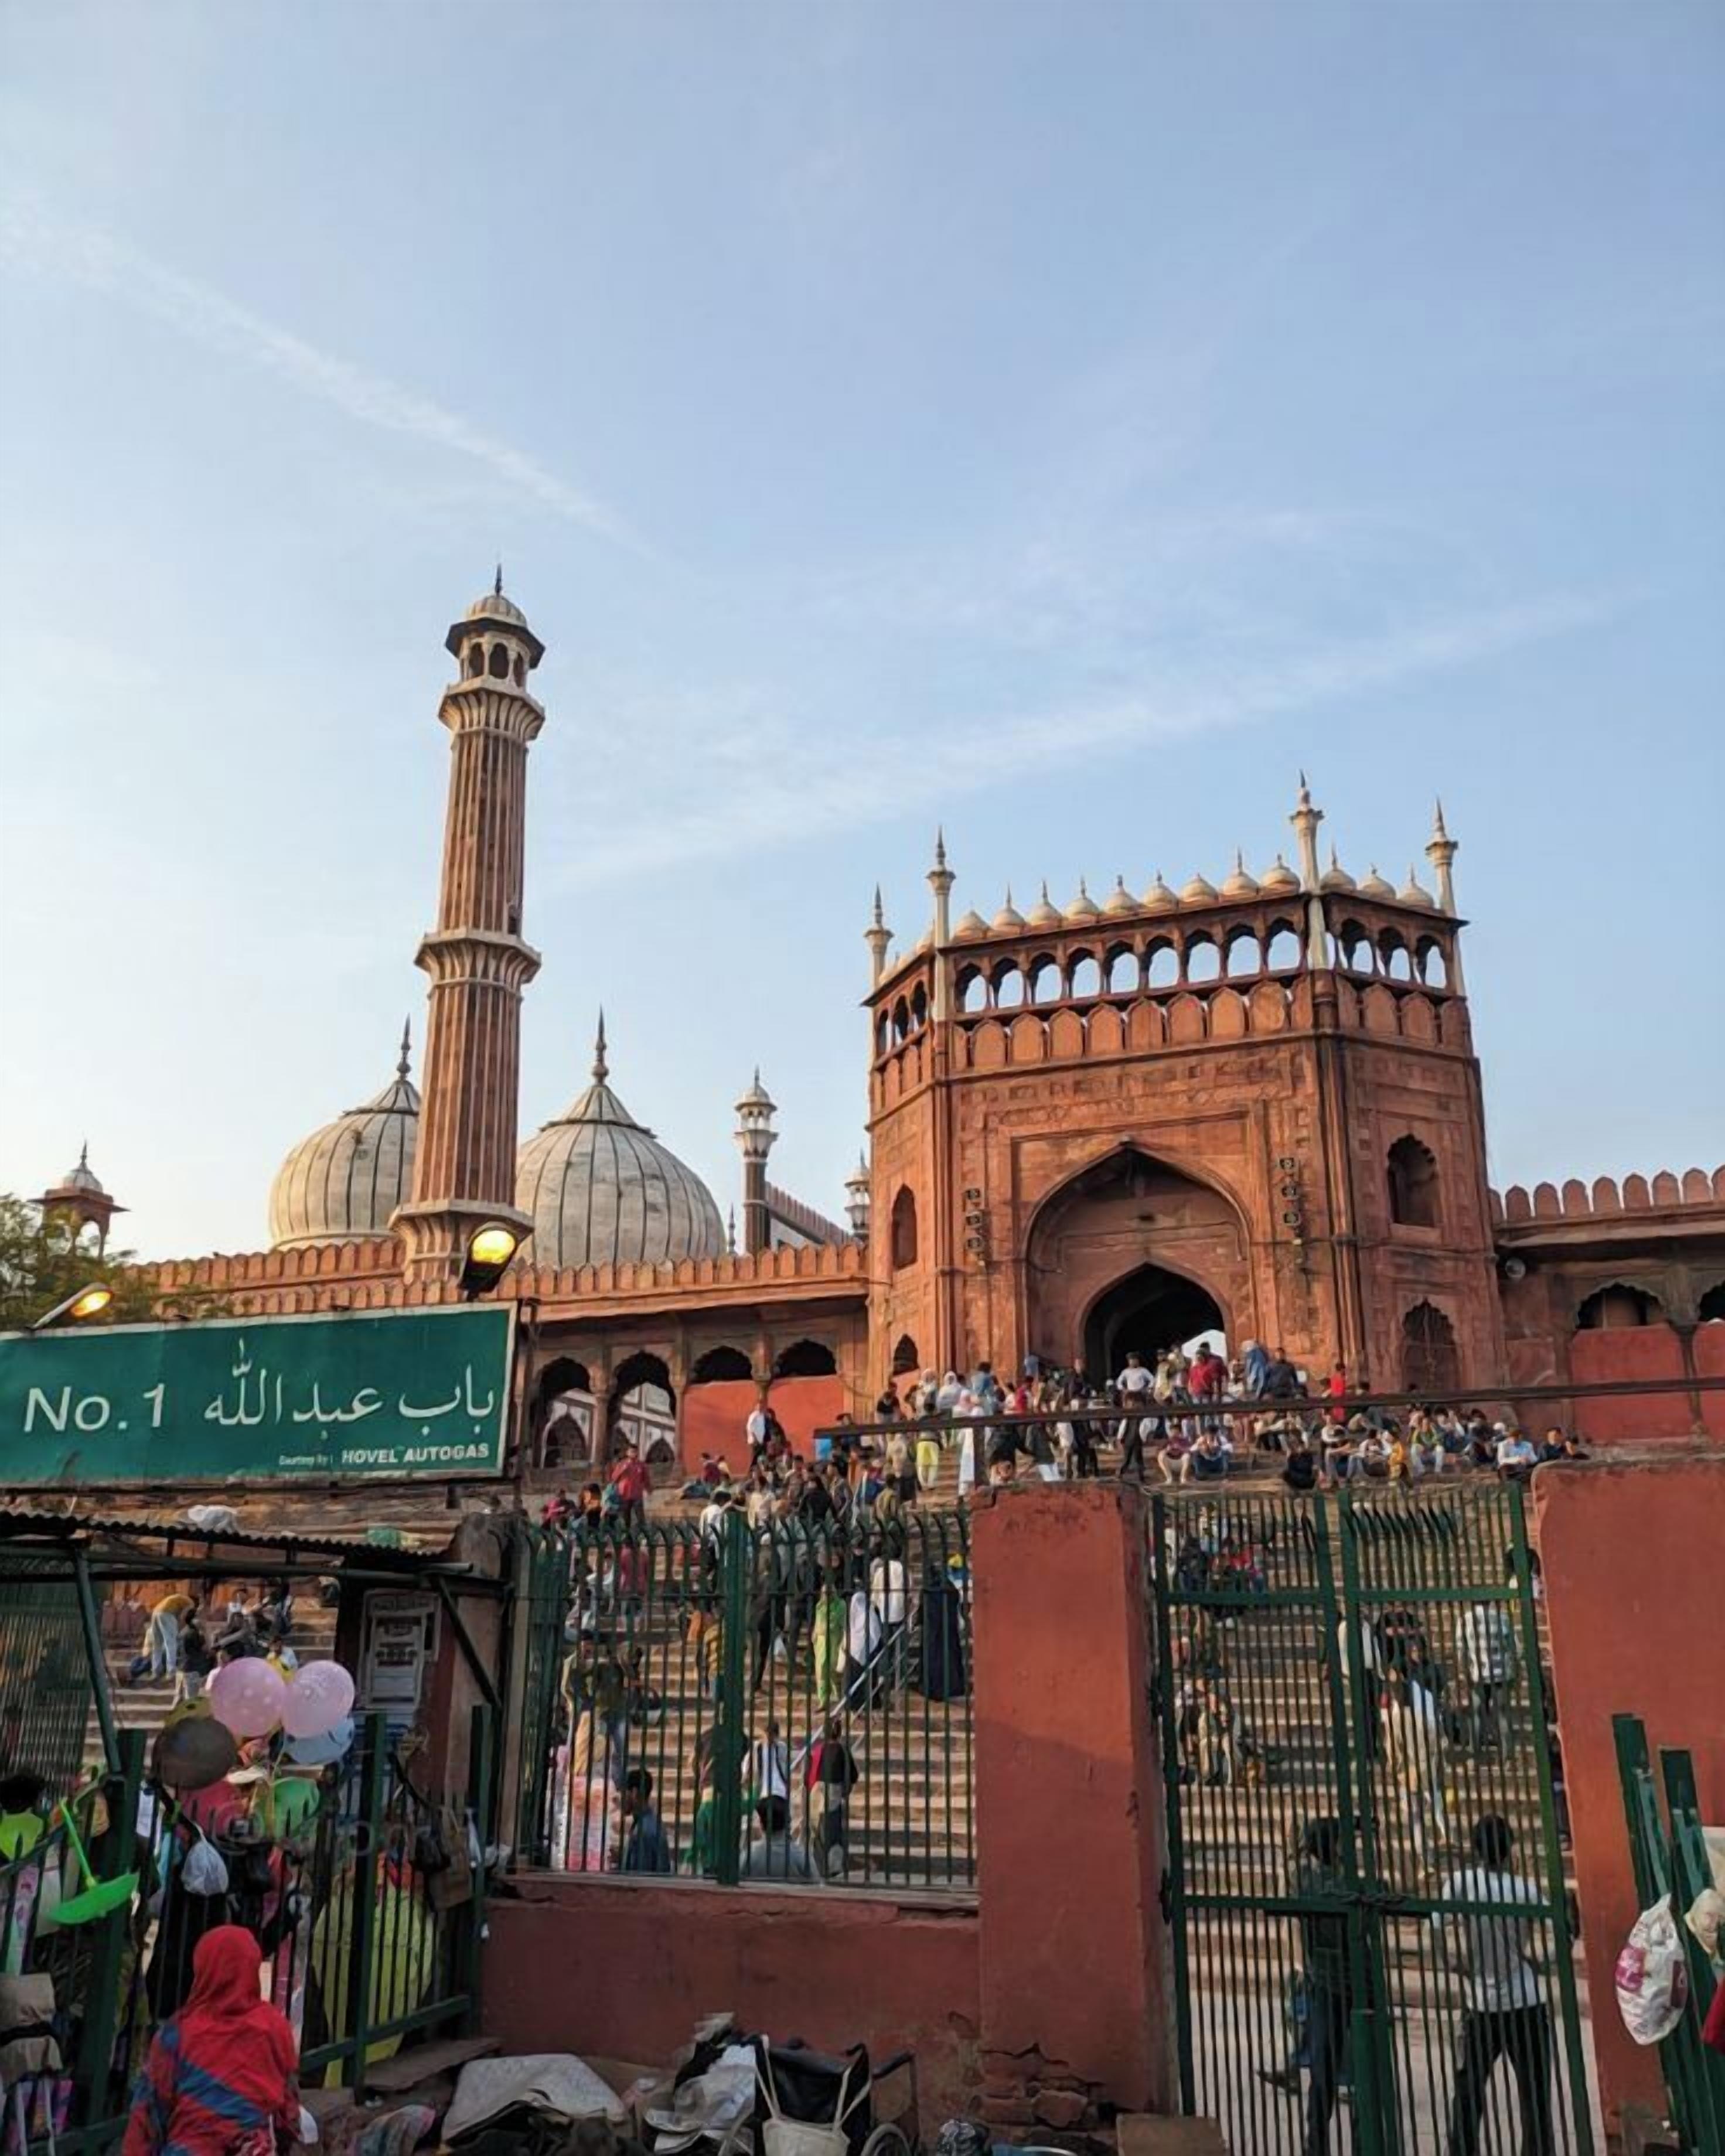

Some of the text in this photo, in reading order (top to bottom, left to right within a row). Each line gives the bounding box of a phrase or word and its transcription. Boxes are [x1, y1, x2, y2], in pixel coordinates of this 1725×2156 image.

[398, 1363, 495, 1435] باب
[342, 1449, 398, 1464] HOVEL
[403, 1443, 489, 1463] AUTOGAS
